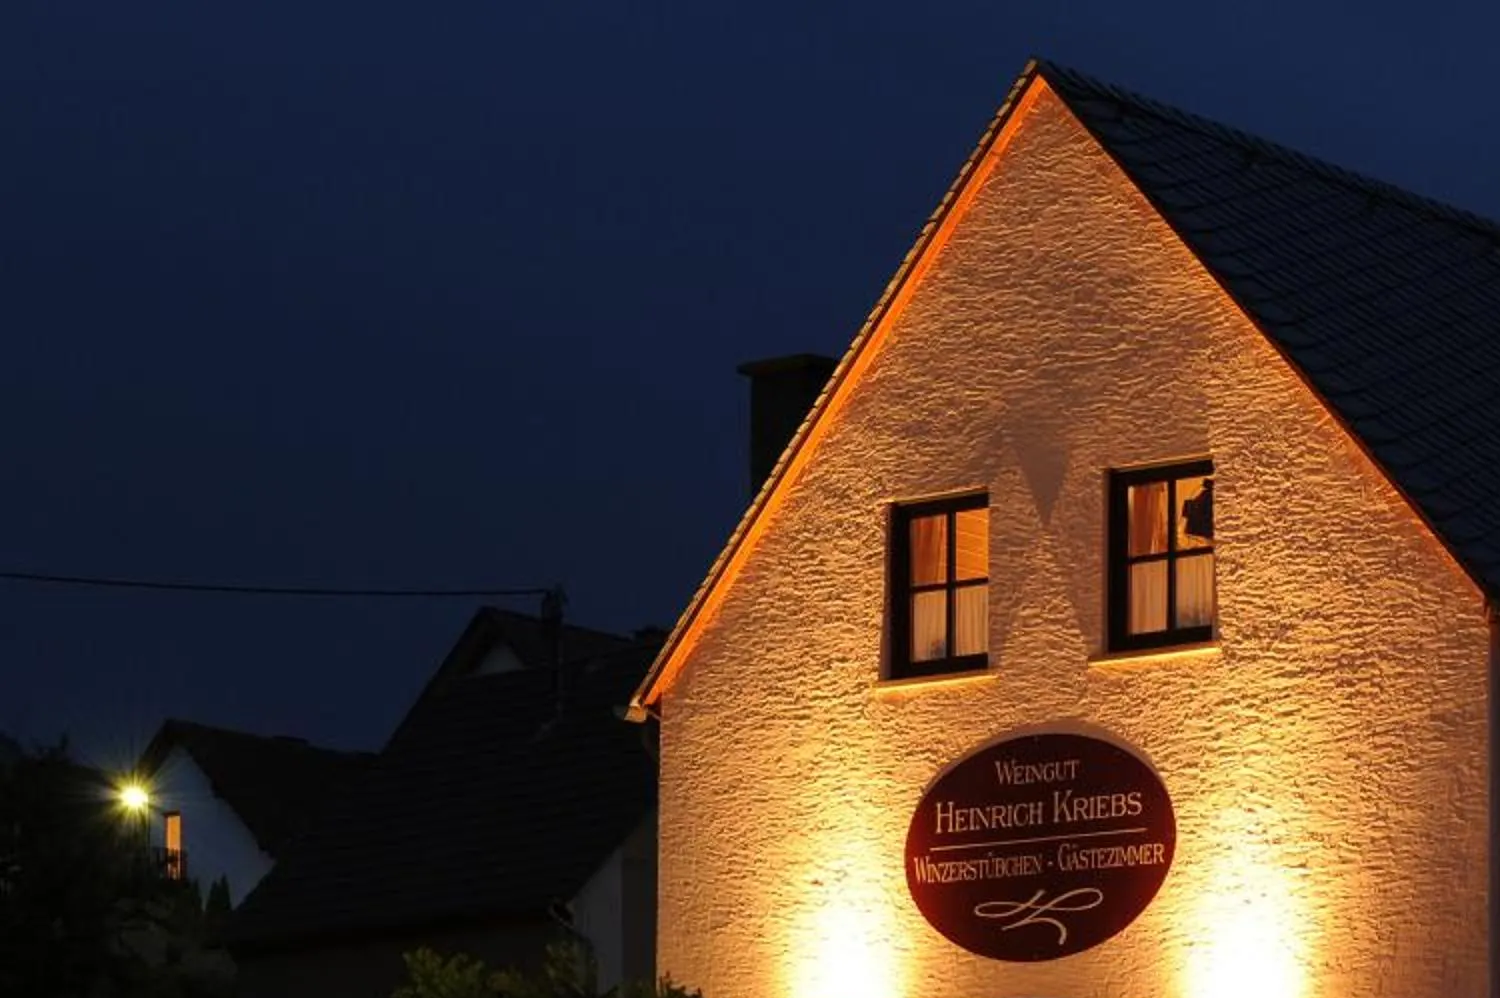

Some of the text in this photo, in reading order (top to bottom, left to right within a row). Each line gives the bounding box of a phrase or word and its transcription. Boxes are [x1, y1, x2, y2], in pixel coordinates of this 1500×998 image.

[995, 760, 1080, 785] WEINGUT
[935, 789, 1143, 834] HEINRICH KRIEBS
[914, 852, 1043, 884] WINZERSTÜBCHEN
[1058, 843, 1165, 871] GÄSTEZIMMER
